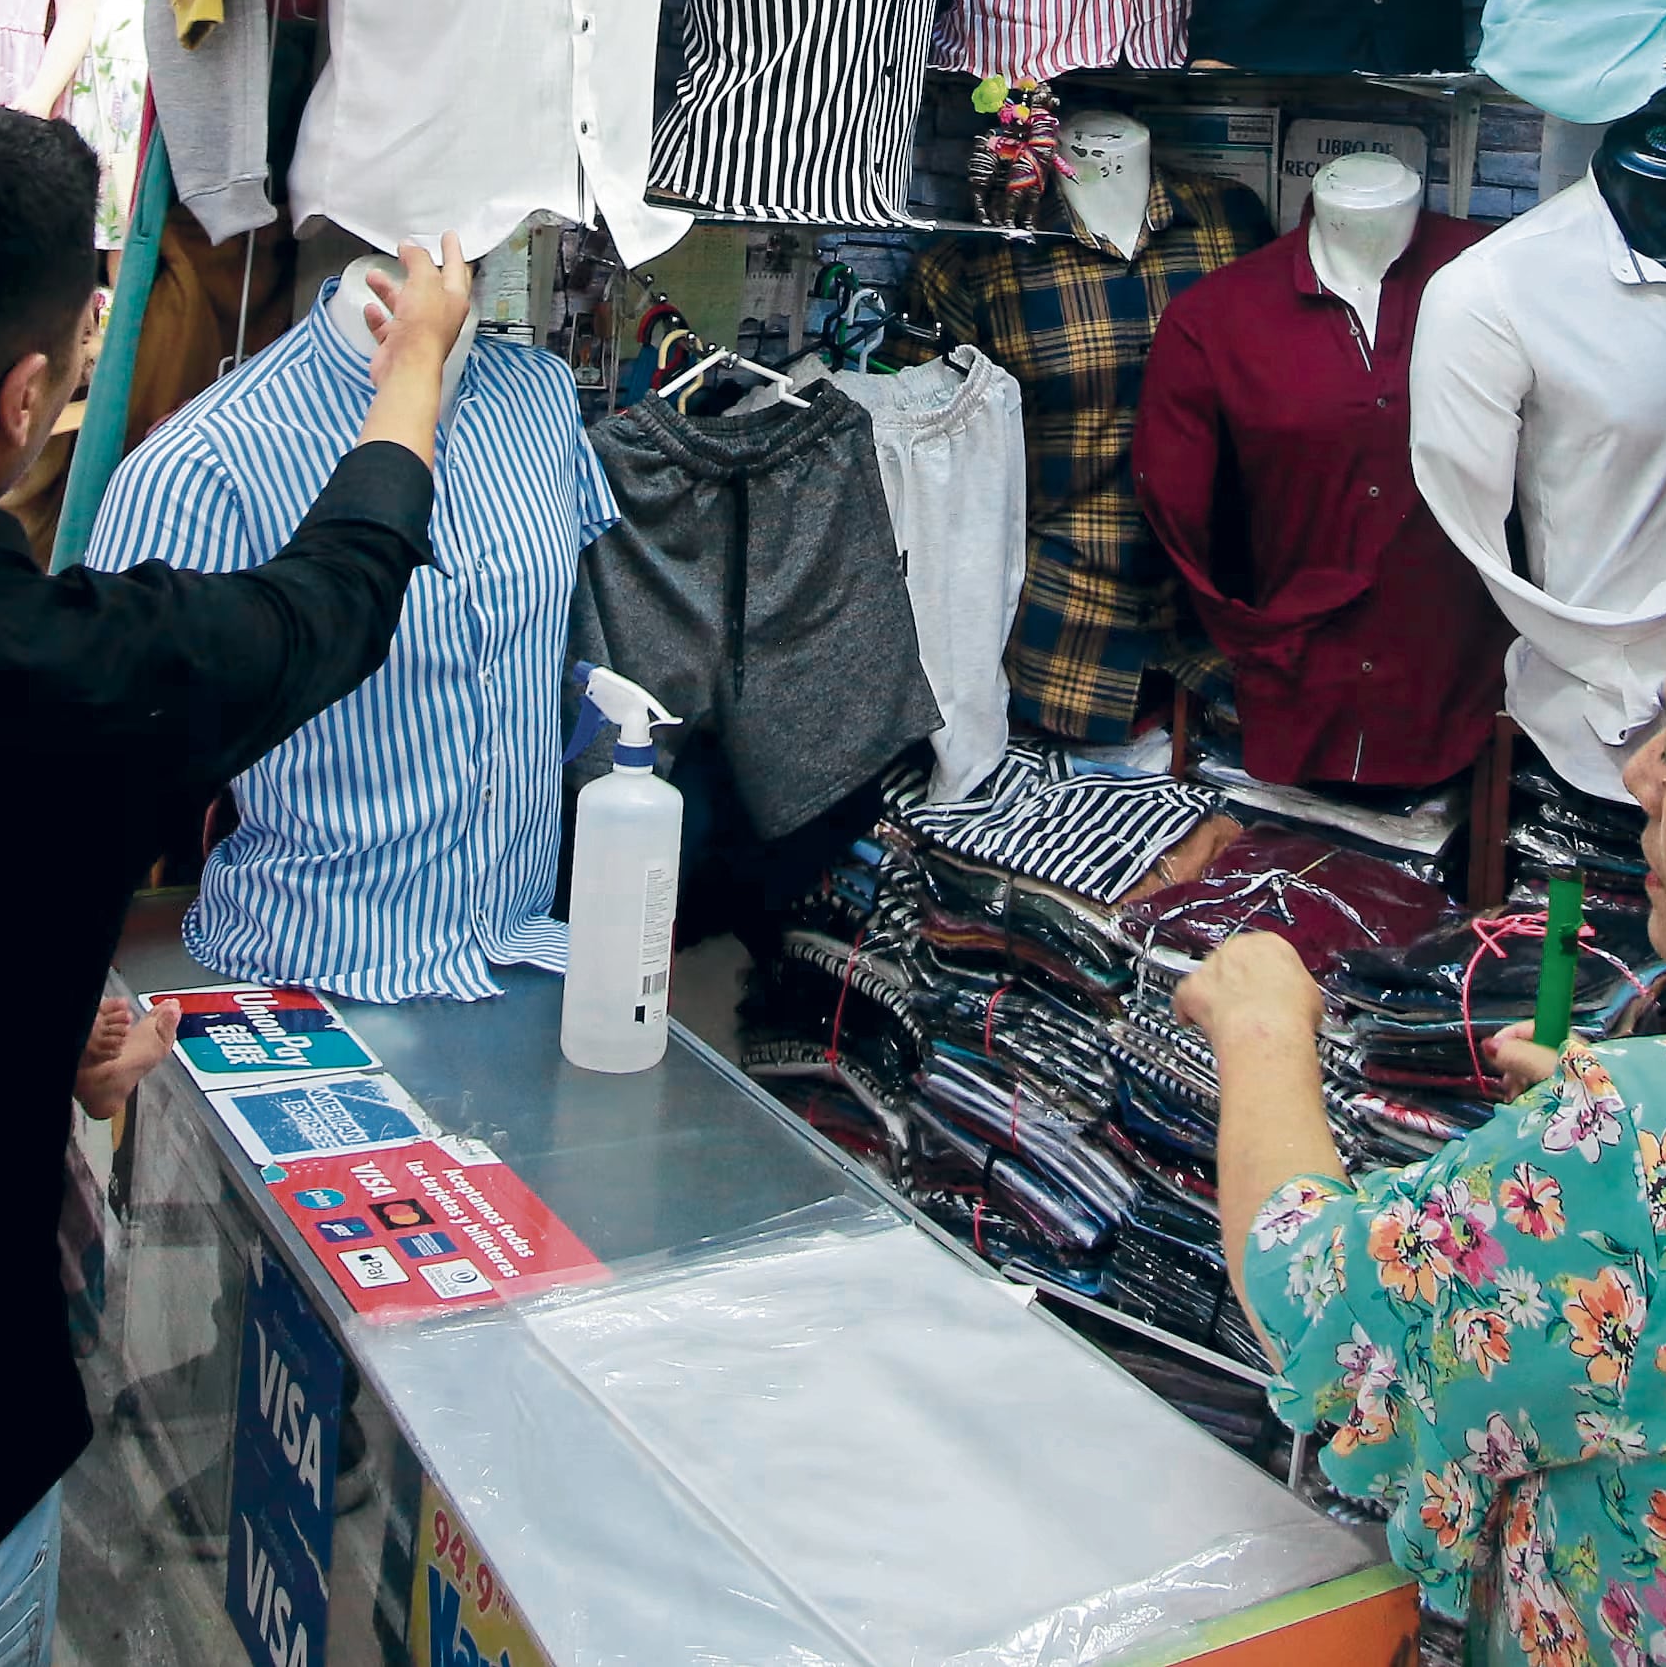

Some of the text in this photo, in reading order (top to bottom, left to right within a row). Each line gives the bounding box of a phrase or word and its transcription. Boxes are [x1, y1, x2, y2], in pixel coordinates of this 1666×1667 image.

[1317, 138, 1365, 155] LIBRO
[233, 992, 313, 1067] UnionPay
[349, 1159, 398, 1199] VISA
[405, 1159, 520, 1279] las tarjetas y billeteras
[441, 1167, 535, 1259] Aceptamos todas
[367, 1261, 388, 1281] Pay
[254, 1317, 321, 1511] VISA
[434, 1509, 493, 1613] 94.9
